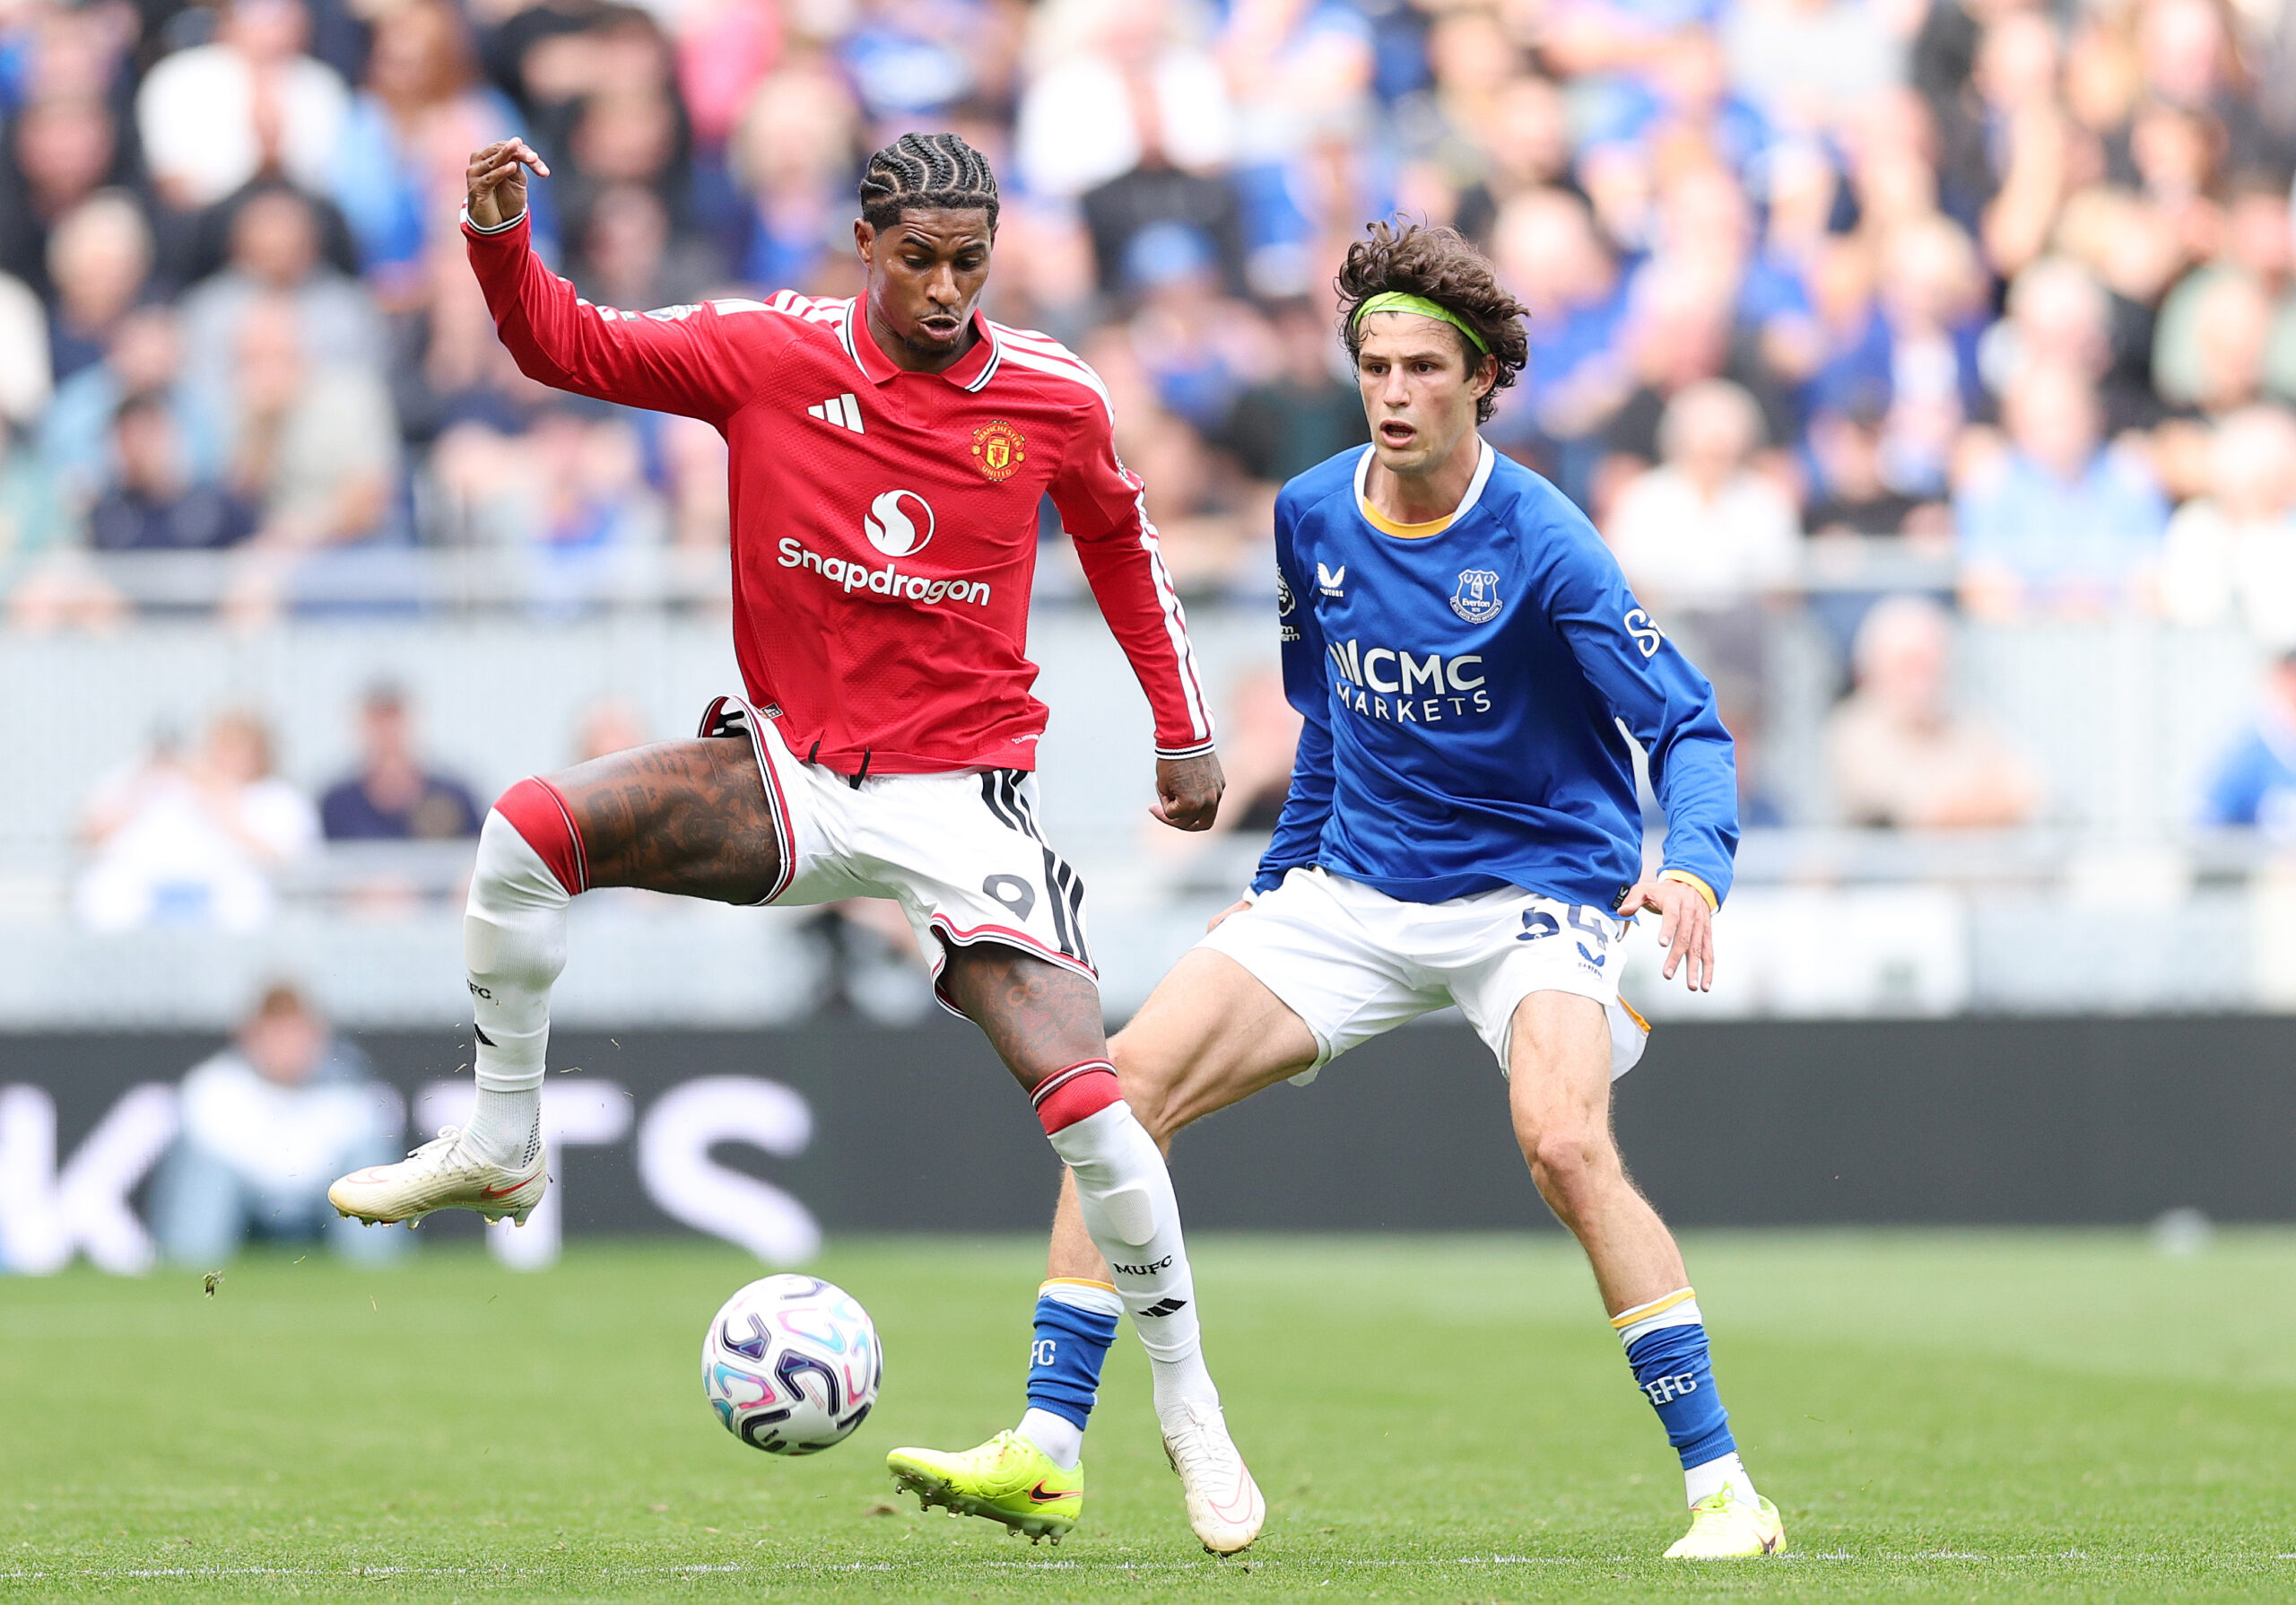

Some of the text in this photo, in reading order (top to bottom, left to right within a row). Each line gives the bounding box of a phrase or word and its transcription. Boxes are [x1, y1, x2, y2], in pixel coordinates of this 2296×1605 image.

[977, 425, 1021, 447] MANCHESTER
[982, 466, 1012, 477] UNITED
[777, 537, 992, 606] Snapdragon
[1462, 598, 1491, 608] Everton
[1363, 647, 1486, 695] CMC
[1336, 689, 1492, 723] MARKETS
[982, 874, 1036, 923] 9
[466, 978, 491, 999] FC
[0, 1075, 825, 1276] KTS
[1112, 1255, 1173, 1276] MUFC
[1646, 1372, 1698, 1406] EFC
